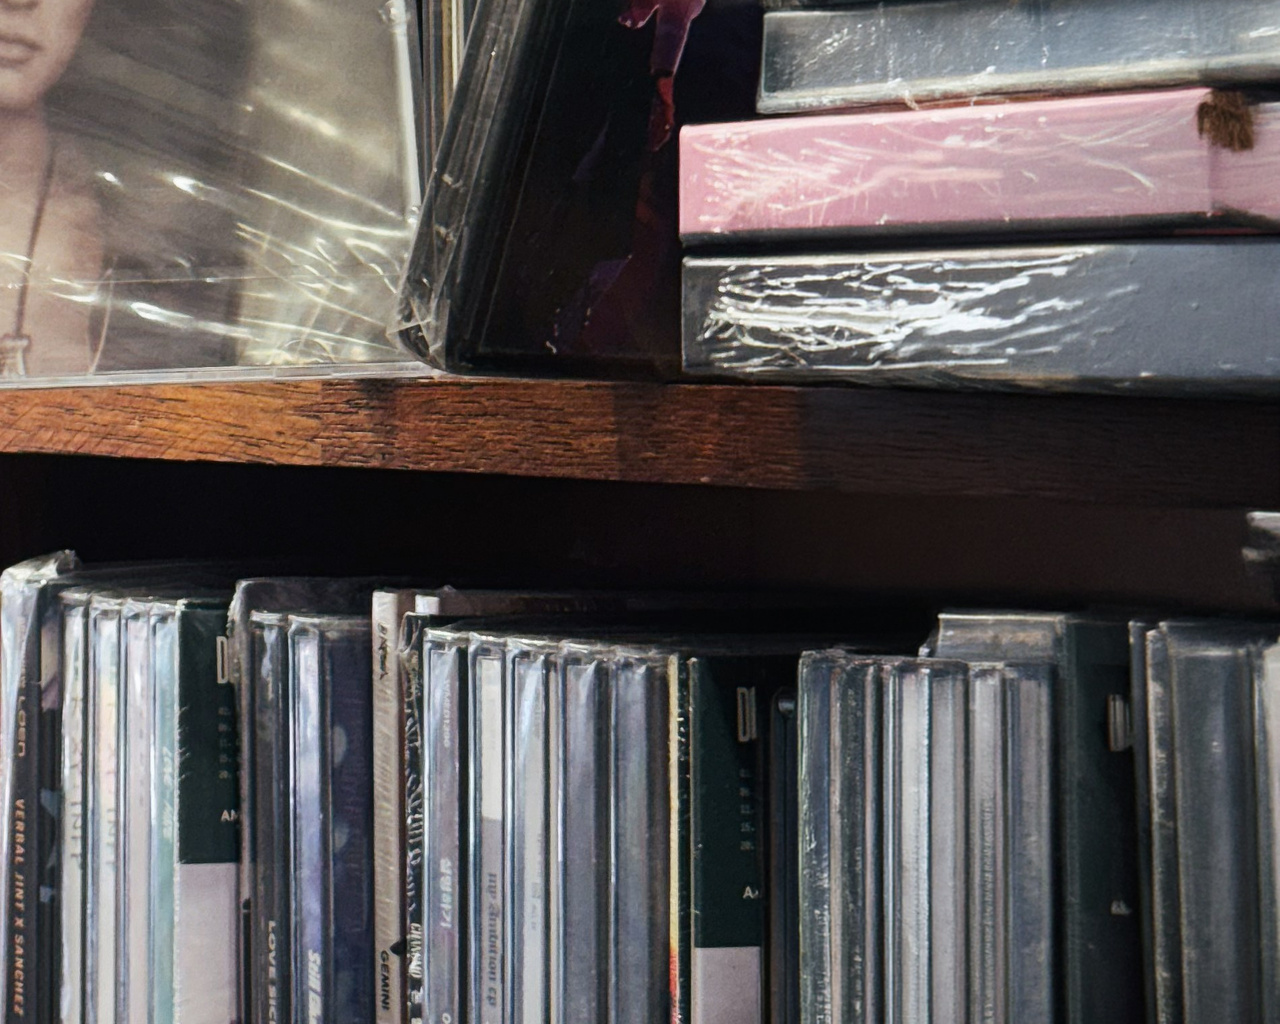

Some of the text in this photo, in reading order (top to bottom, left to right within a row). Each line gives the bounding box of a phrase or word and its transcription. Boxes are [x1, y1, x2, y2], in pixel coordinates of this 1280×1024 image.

[13, 798, 25, 866] VERBAL
[13, 871, 25, 913] JINT
[12, 934, 25, 1018] SANCHEZ
[379, 949, 391, 1012] GEMINI
